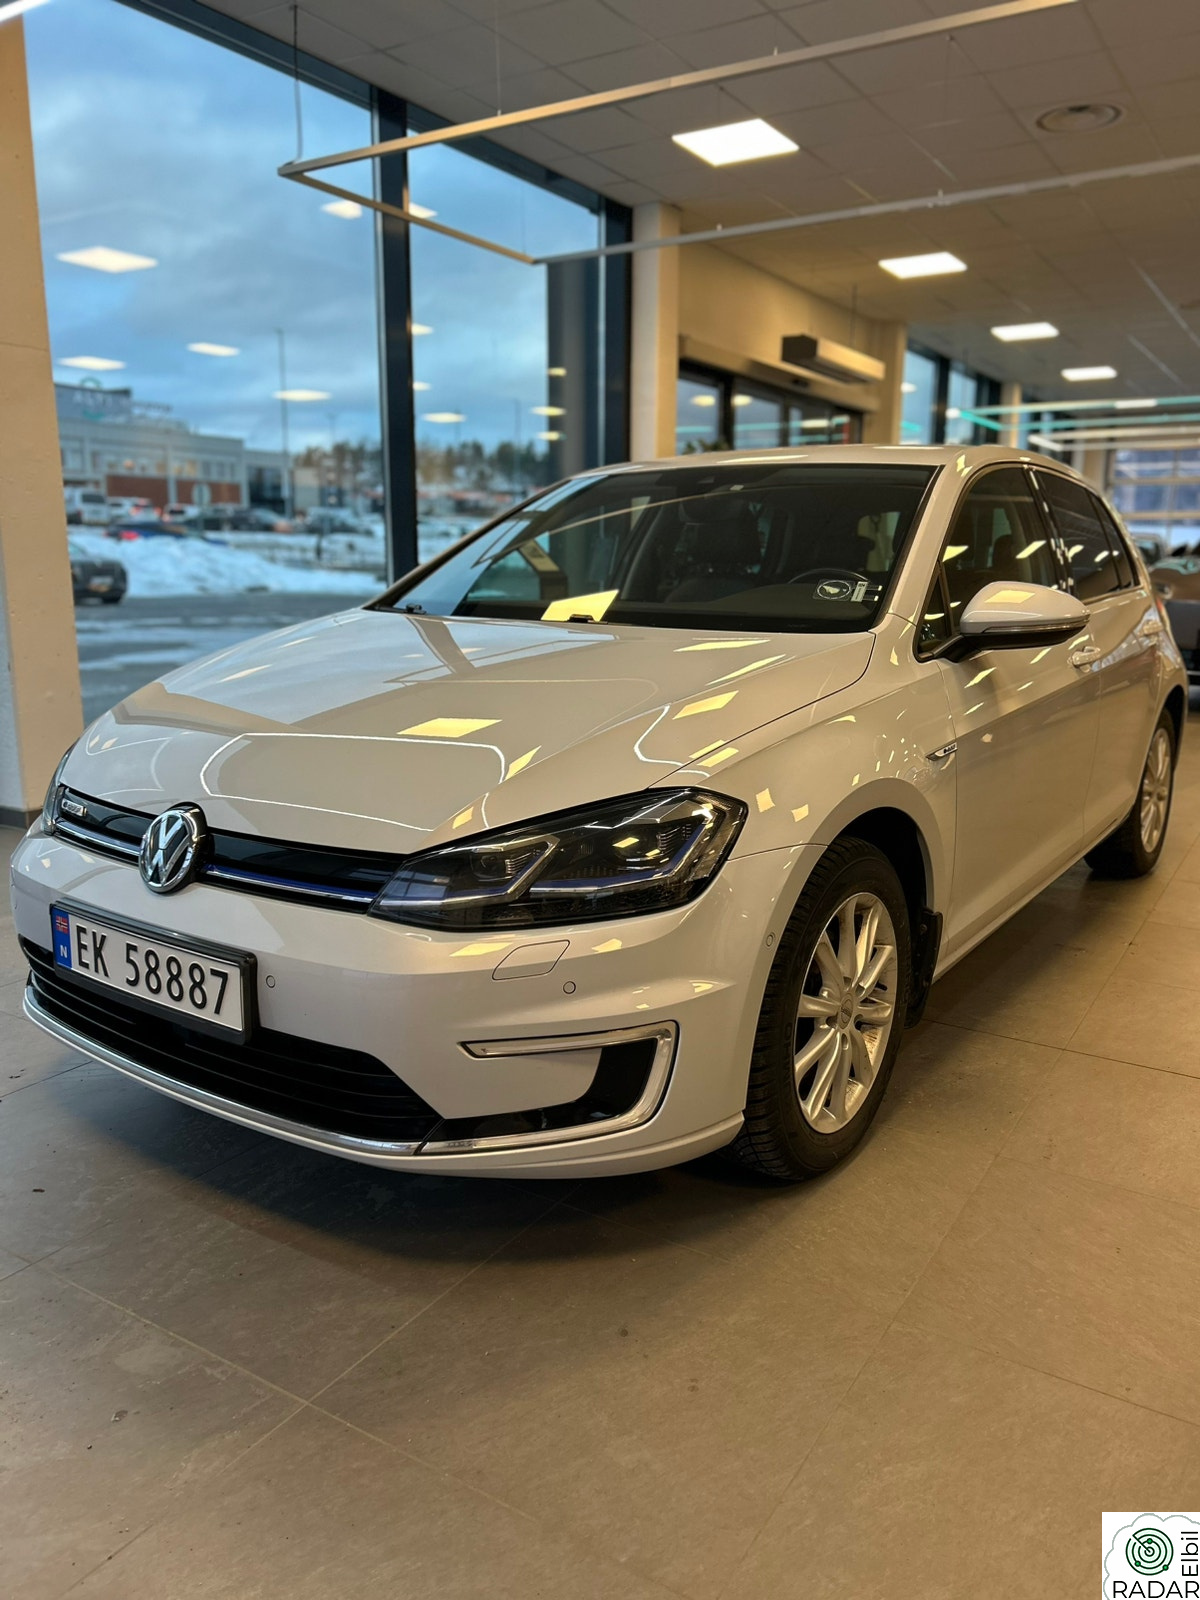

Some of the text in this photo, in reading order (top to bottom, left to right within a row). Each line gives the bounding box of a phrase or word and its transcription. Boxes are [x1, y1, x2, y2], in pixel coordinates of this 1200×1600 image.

[60, 944, 68, 958] N
[76, 924, 229, 1015] EK 58887
